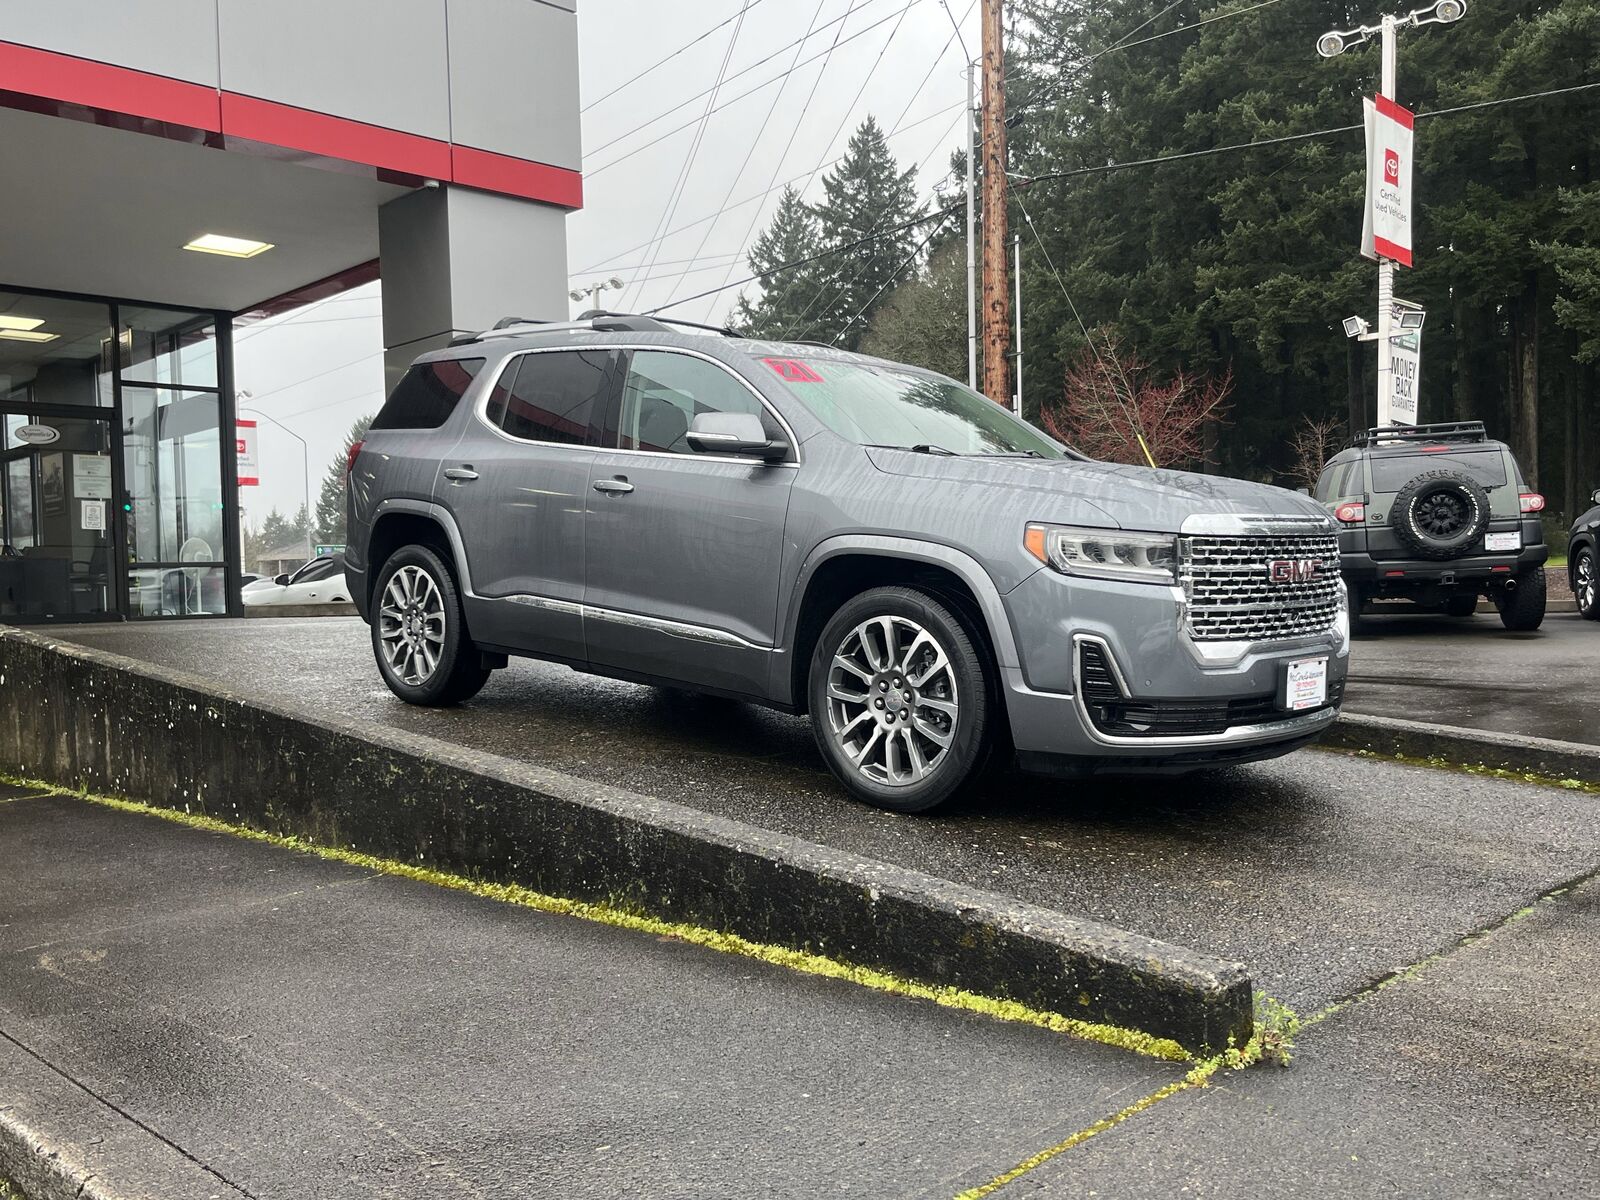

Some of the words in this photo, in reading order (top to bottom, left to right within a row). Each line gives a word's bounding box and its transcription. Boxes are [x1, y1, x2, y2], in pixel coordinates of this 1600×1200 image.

[1380, 188, 1401, 206] Certified
[1375, 200, 1387, 213] Used
[1388, 204, 1407, 222] Vehicles
[1391, 356, 1416, 380] MONEY
[1396, 377, 1412, 398] BACK
[1391, 394, 1415, 413] GUARANTEE
[1268, 559, 1324, 582] GMC
